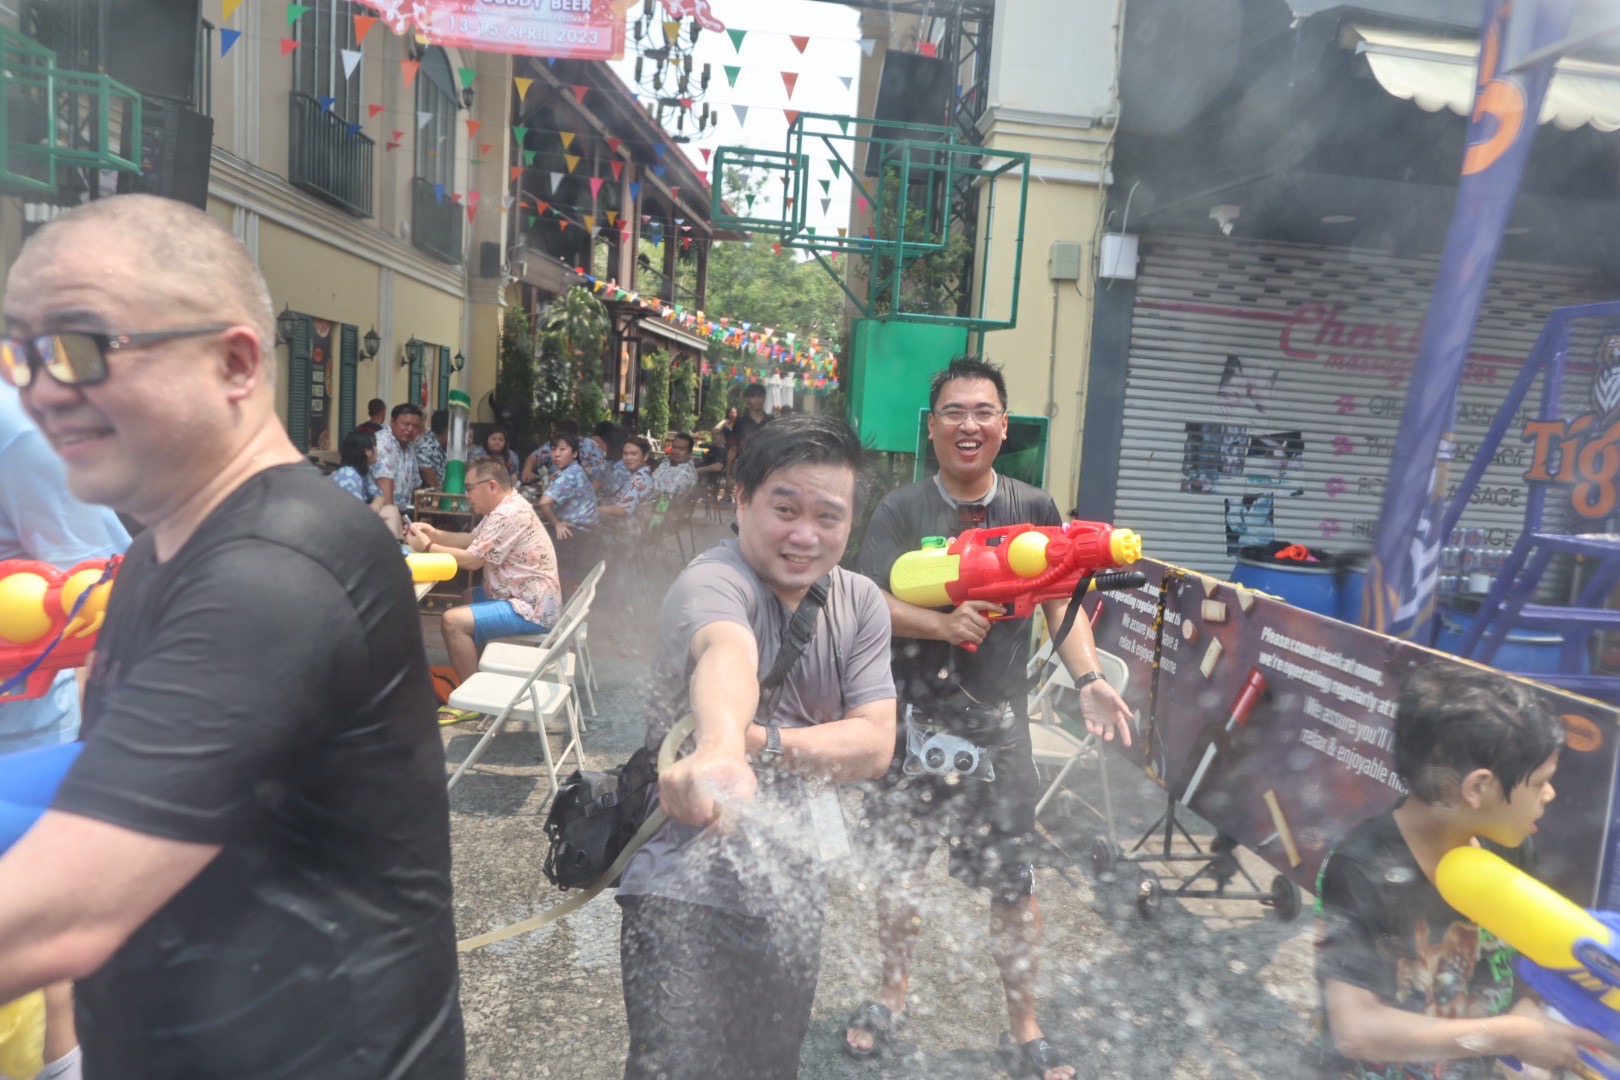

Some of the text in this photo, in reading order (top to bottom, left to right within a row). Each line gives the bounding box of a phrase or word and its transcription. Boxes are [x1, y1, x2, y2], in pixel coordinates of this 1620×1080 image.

[551, 0, 592, 11] BEER
[449, 16, 599, 45] 13-15 APRIL 2023
[1454, 441, 1526, 466] ASAGE
[1447, 484, 1519, 507] ASAGE
[1122, 612, 1131, 628] We
[1145, 625, 1157, 640] you
[1261, 625, 1291, 650] Please
[1258, 651, 1286, 673] we're
[1331, 678, 1377, 713] regularly
[1303, 695, 1322, 719] We
[1320, 707, 1356, 735] assure
[1301, 728, 1330, 753] relax
[1328, 736, 1338, 757] &
[1337, 743, 1388, 784] enjoyable
